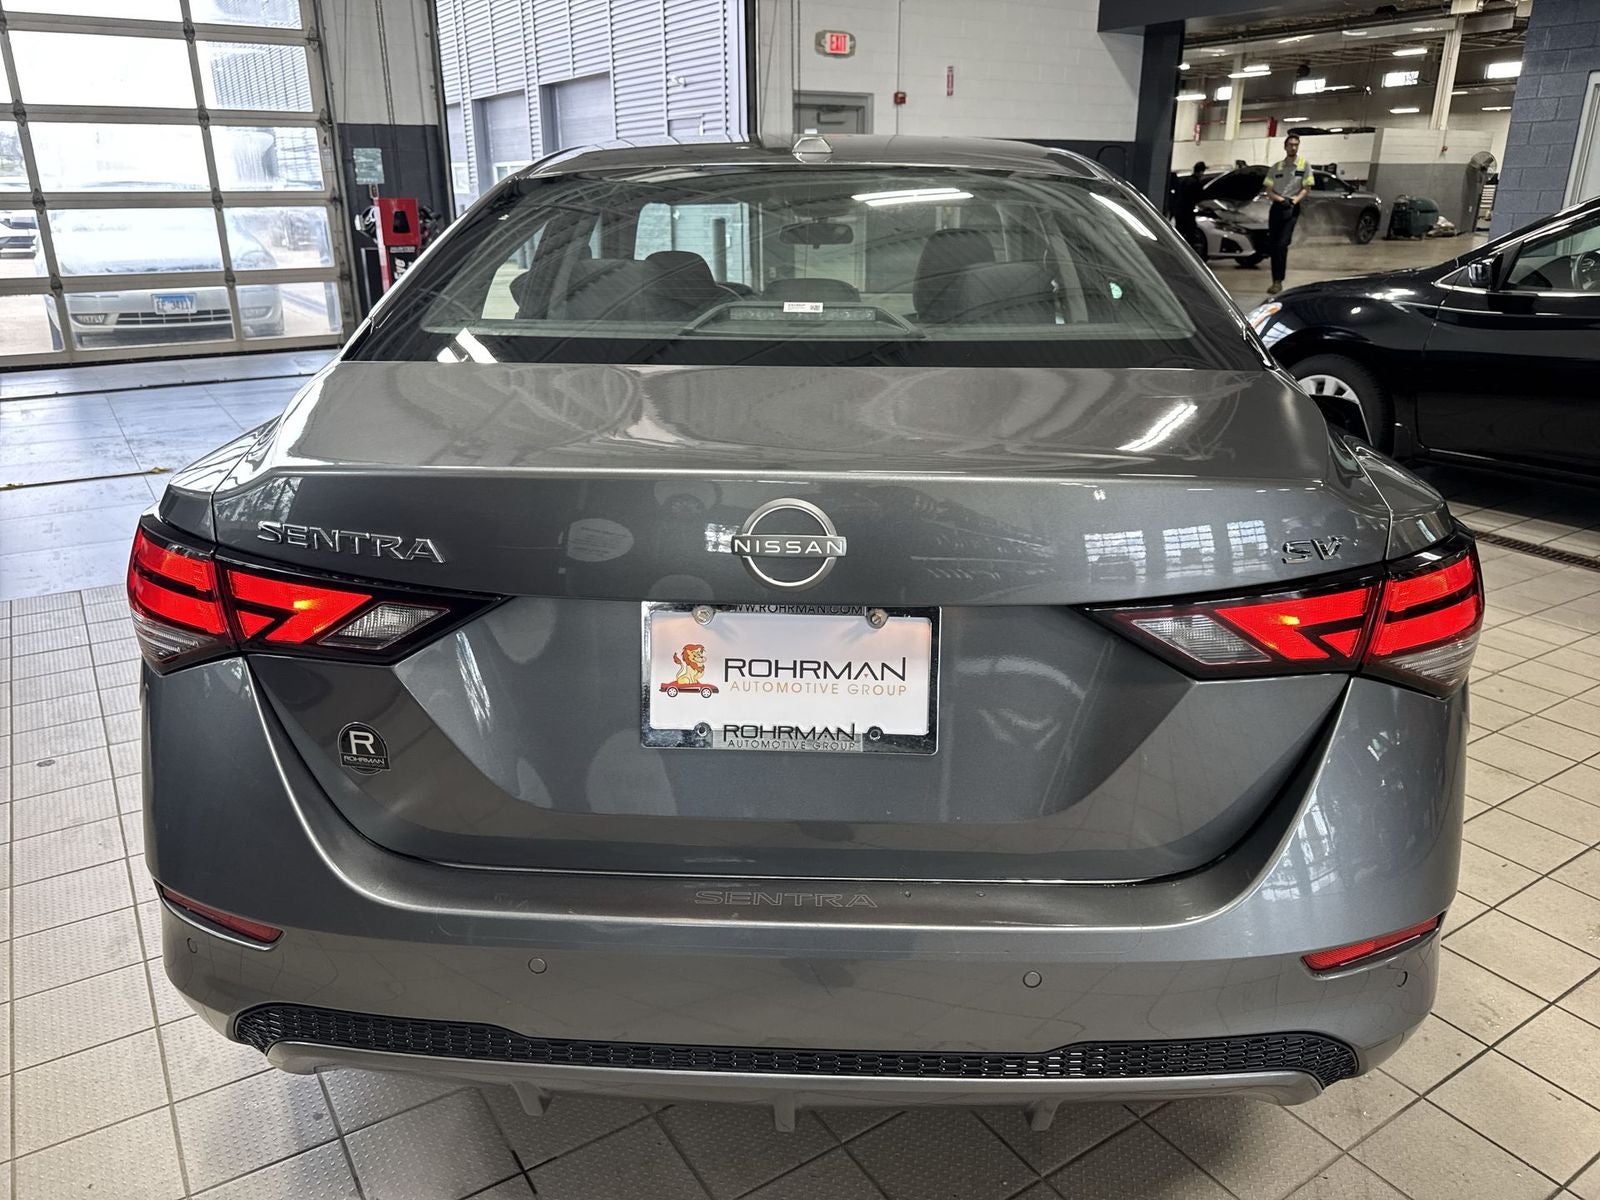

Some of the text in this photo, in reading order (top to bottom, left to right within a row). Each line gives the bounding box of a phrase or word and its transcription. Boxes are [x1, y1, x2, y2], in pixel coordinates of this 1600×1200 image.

[830, 34, 847, 51] EXIT
[257, 520, 446, 564] SENTRA
[734, 539, 842, 554] NISSAN
[1281, 535, 1345, 564] SV
[724, 656, 906, 682] ROHRMAN
[730, 681, 907, 696] AUTOMOTIVE GROUP
[723, 723, 855, 742] ROHRMAN
[349, 730, 376, 755] R
[727, 739, 855, 751] AUTOMOTIVE GROUP
[343, 755, 385, 765] ROHRMAN
[694, 890, 879, 908] SENTRA
